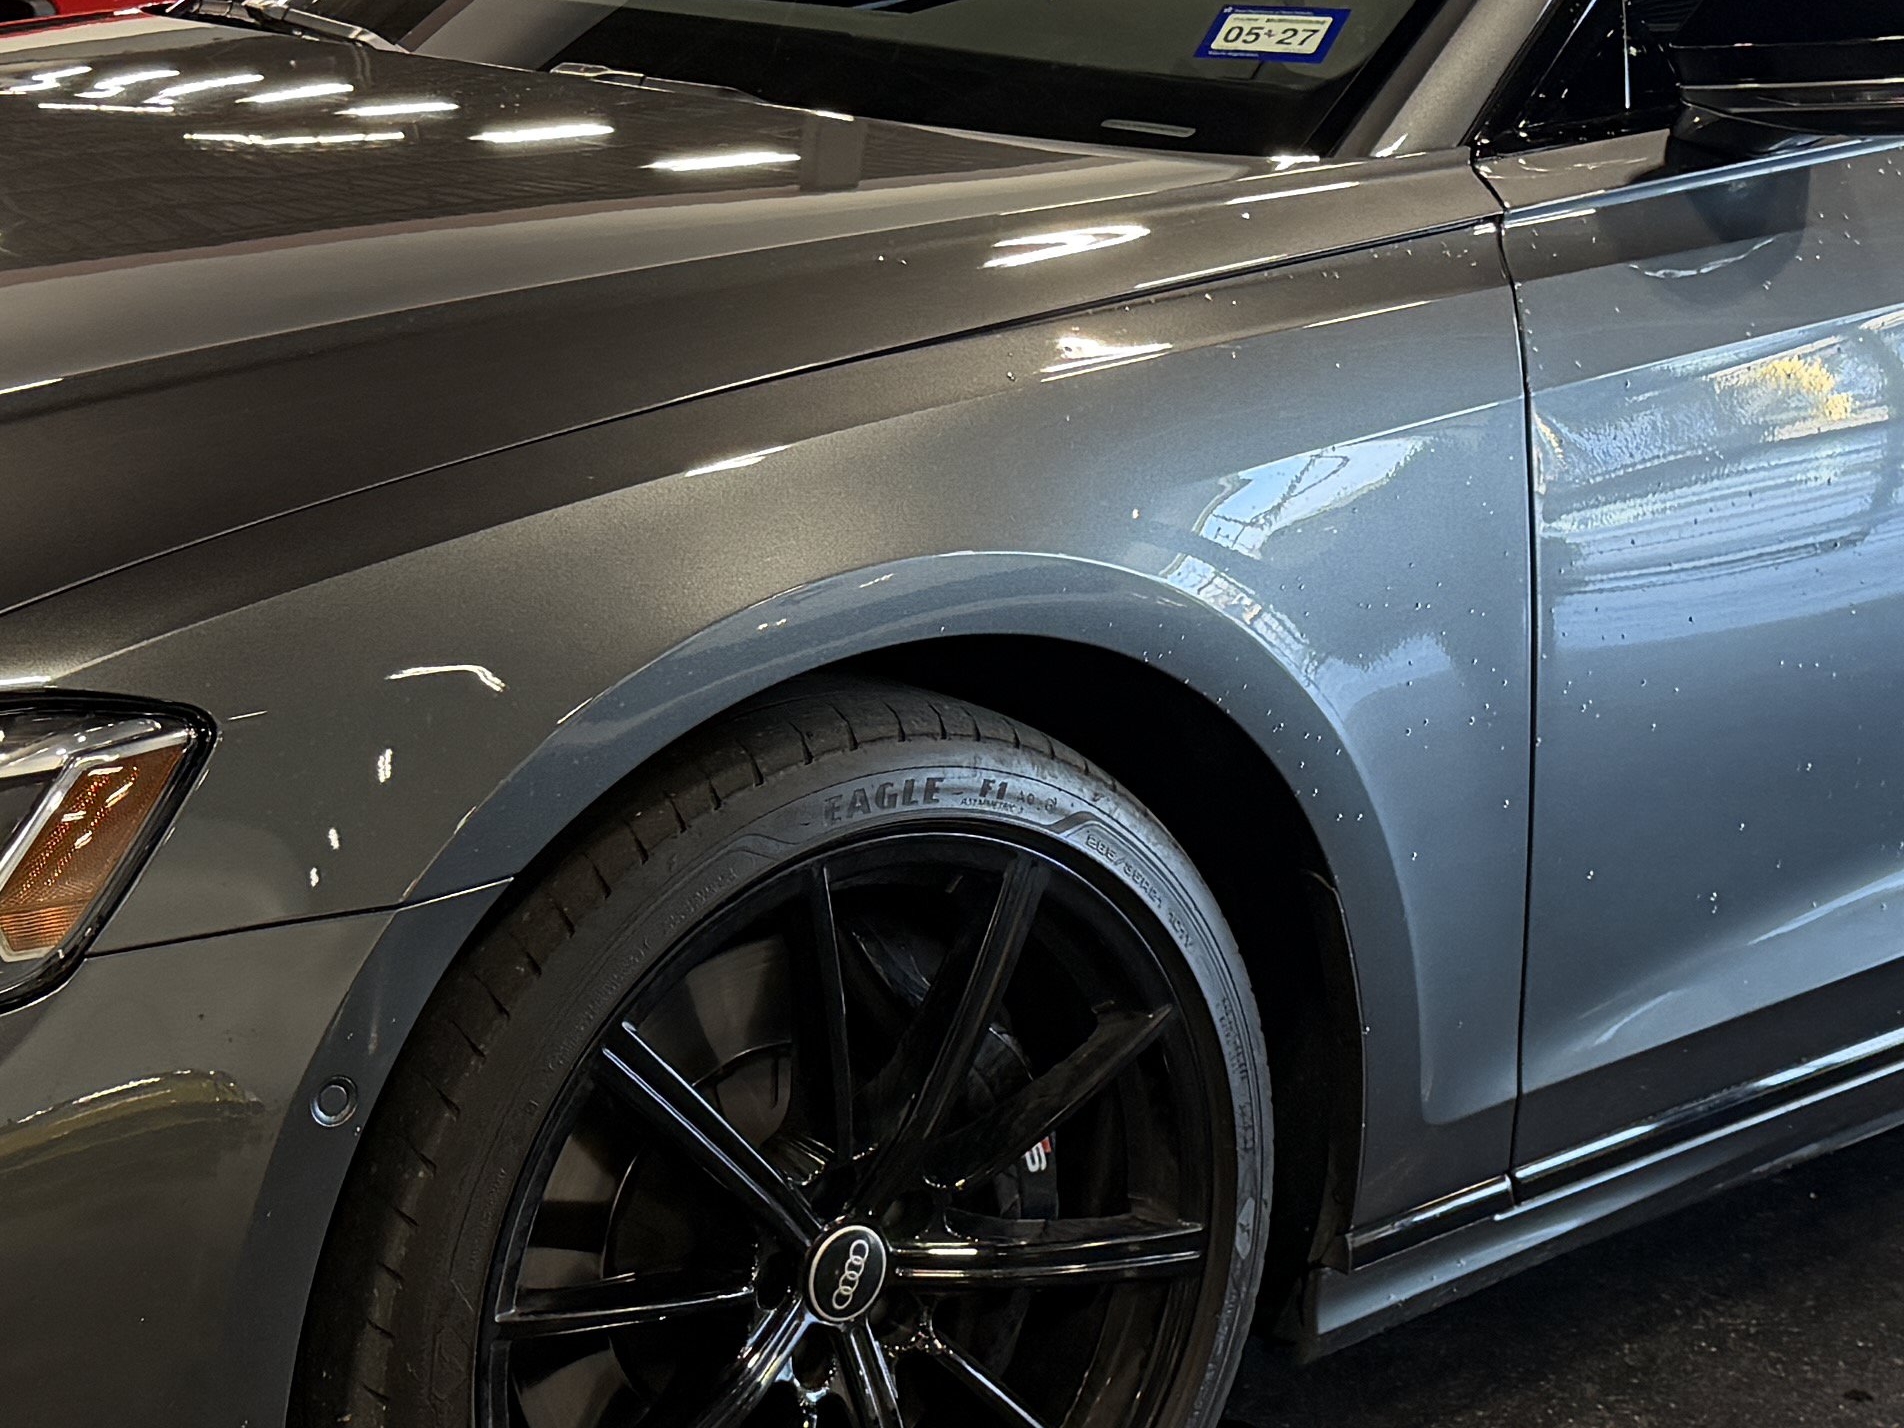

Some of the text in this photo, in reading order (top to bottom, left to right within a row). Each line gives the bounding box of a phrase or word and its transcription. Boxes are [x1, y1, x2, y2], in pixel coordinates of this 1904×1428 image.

[1223, 26, 1320, 47] 05 27
[823, 777, 946, 823] EAGLE
[978, 778, 1009, 801] F1
